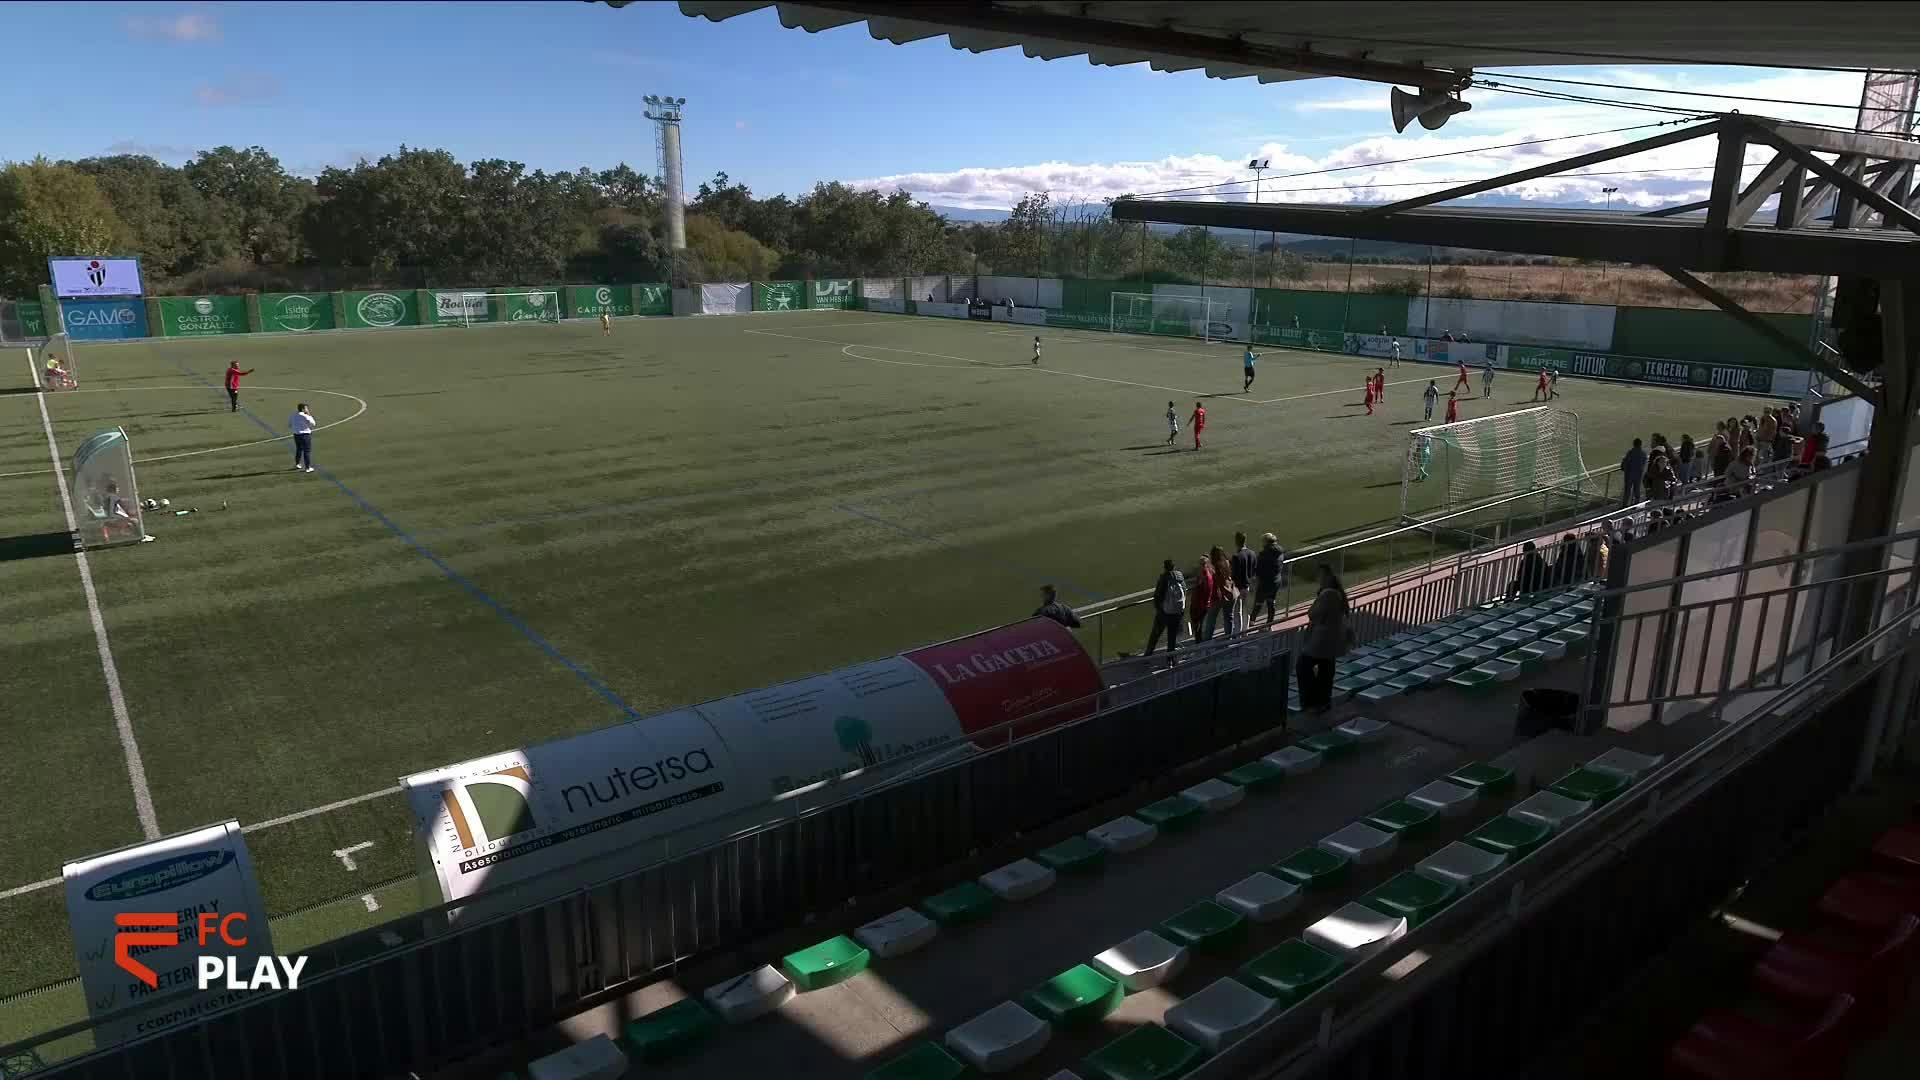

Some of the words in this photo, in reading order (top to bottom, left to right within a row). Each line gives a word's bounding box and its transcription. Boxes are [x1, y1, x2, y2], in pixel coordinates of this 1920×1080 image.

[177, 314, 220, 323] CASTRO
[577, 305, 631, 313] CARRASCO
[1645, 361, 1689, 377] TERCERA
[1711, 367, 1749, 389] FUTUR
[969, 639, 1061, 674] GACETA
[560, 748, 714, 813] nutersa
[463, 838, 553, 873] Asesoramiento
